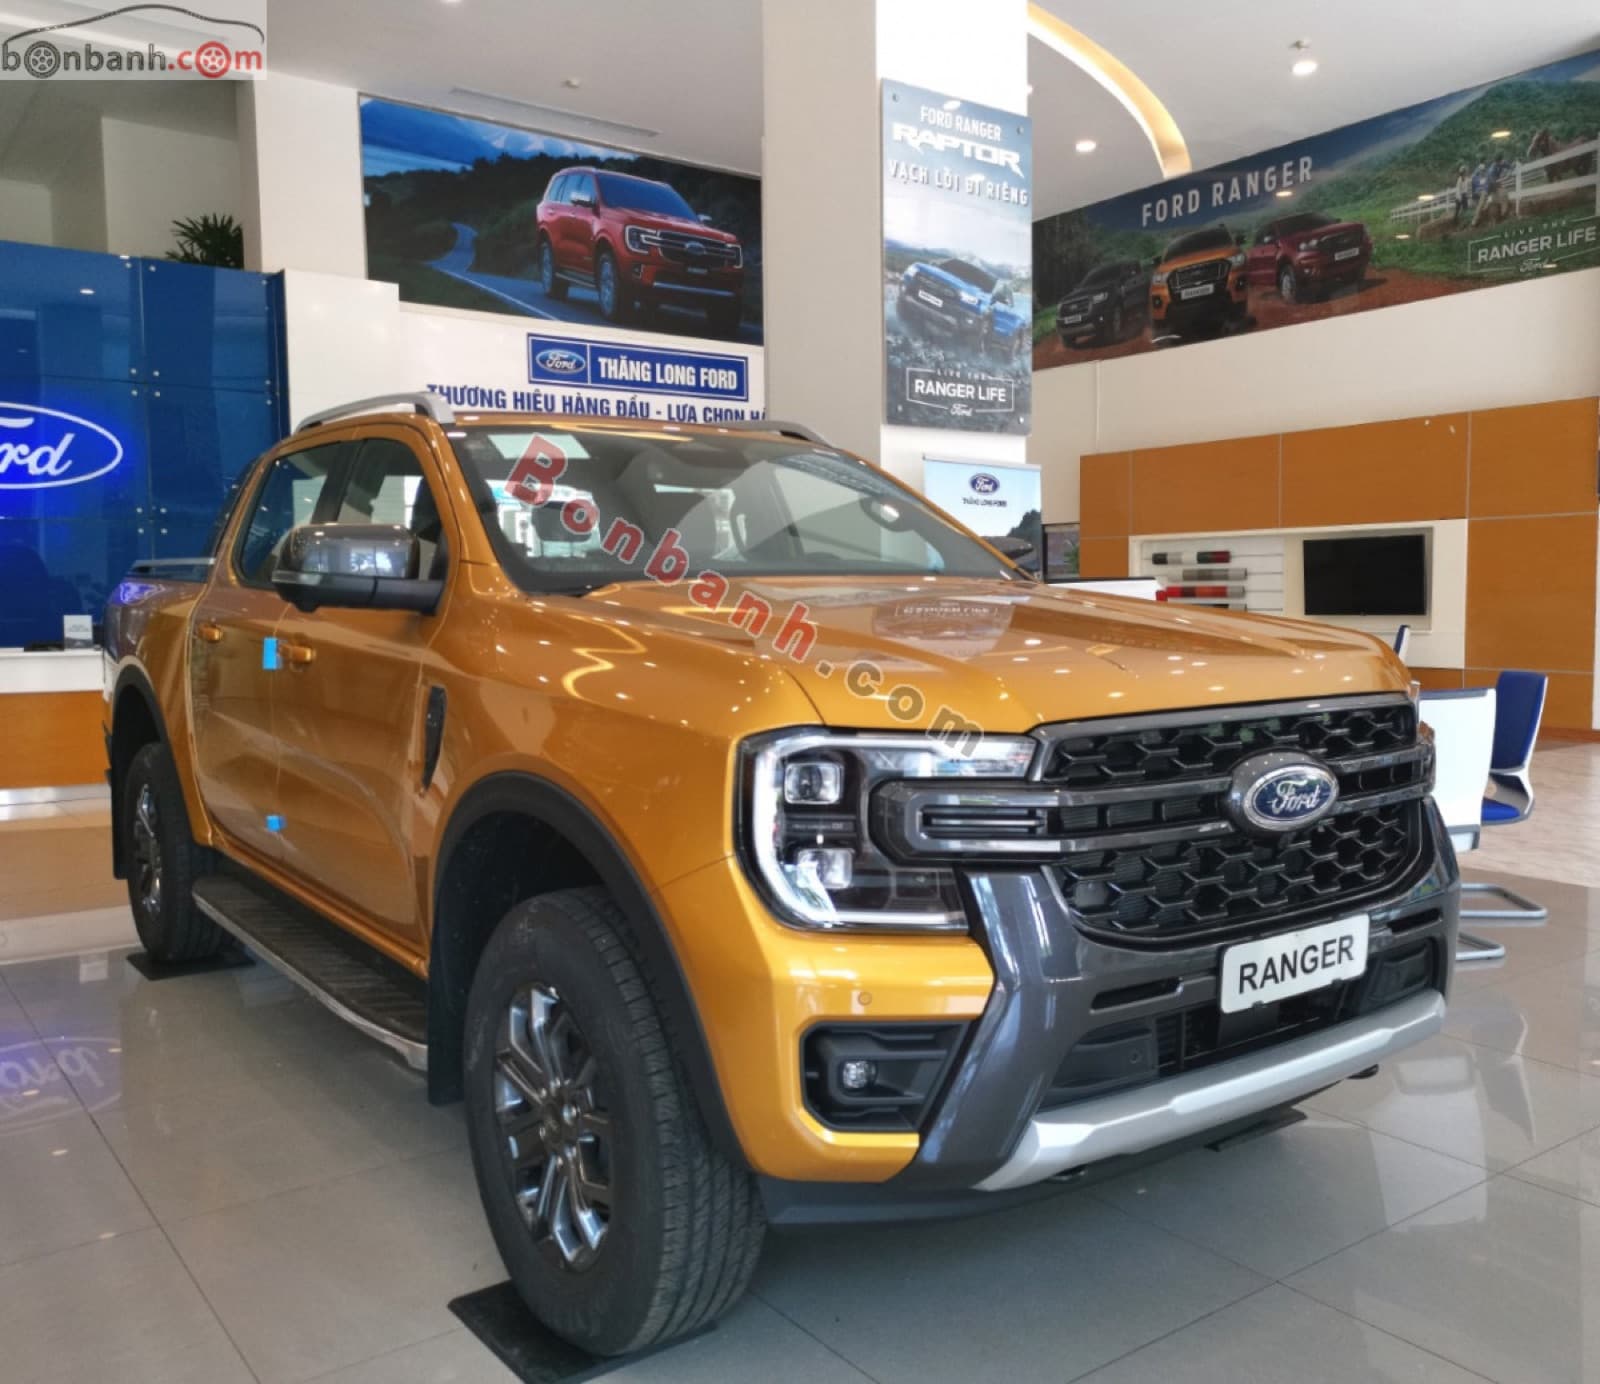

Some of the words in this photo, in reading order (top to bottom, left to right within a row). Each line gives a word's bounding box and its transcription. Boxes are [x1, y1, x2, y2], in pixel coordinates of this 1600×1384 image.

[920, 105, 952, 128] FORD
[956, 114, 1002, 141] RANGER
[892, 121, 1024, 179] RAPTOR
[986, 180, 1029, 207] RIÊNG
[1142, 189, 1200, 227] FORD
[1211, 156, 1313, 207] RANGER
[1477, 235, 1552, 264] RANGER
[1556, 226, 1597, 248] LIFE
[598, 355, 652, 382] THĂNG
[655, 363, 696, 386] LONG
[700, 367, 737, 390] FORD
[562, 392, 610, 416] HÀNG
[914, 379, 975, 399] RANGER
[978, 385, 1006, 402] LIFE
[950, 403, 973, 417] Ford
[1271, 780, 1321, 815] Ford
[1238, 934, 1355, 994] RANGER
